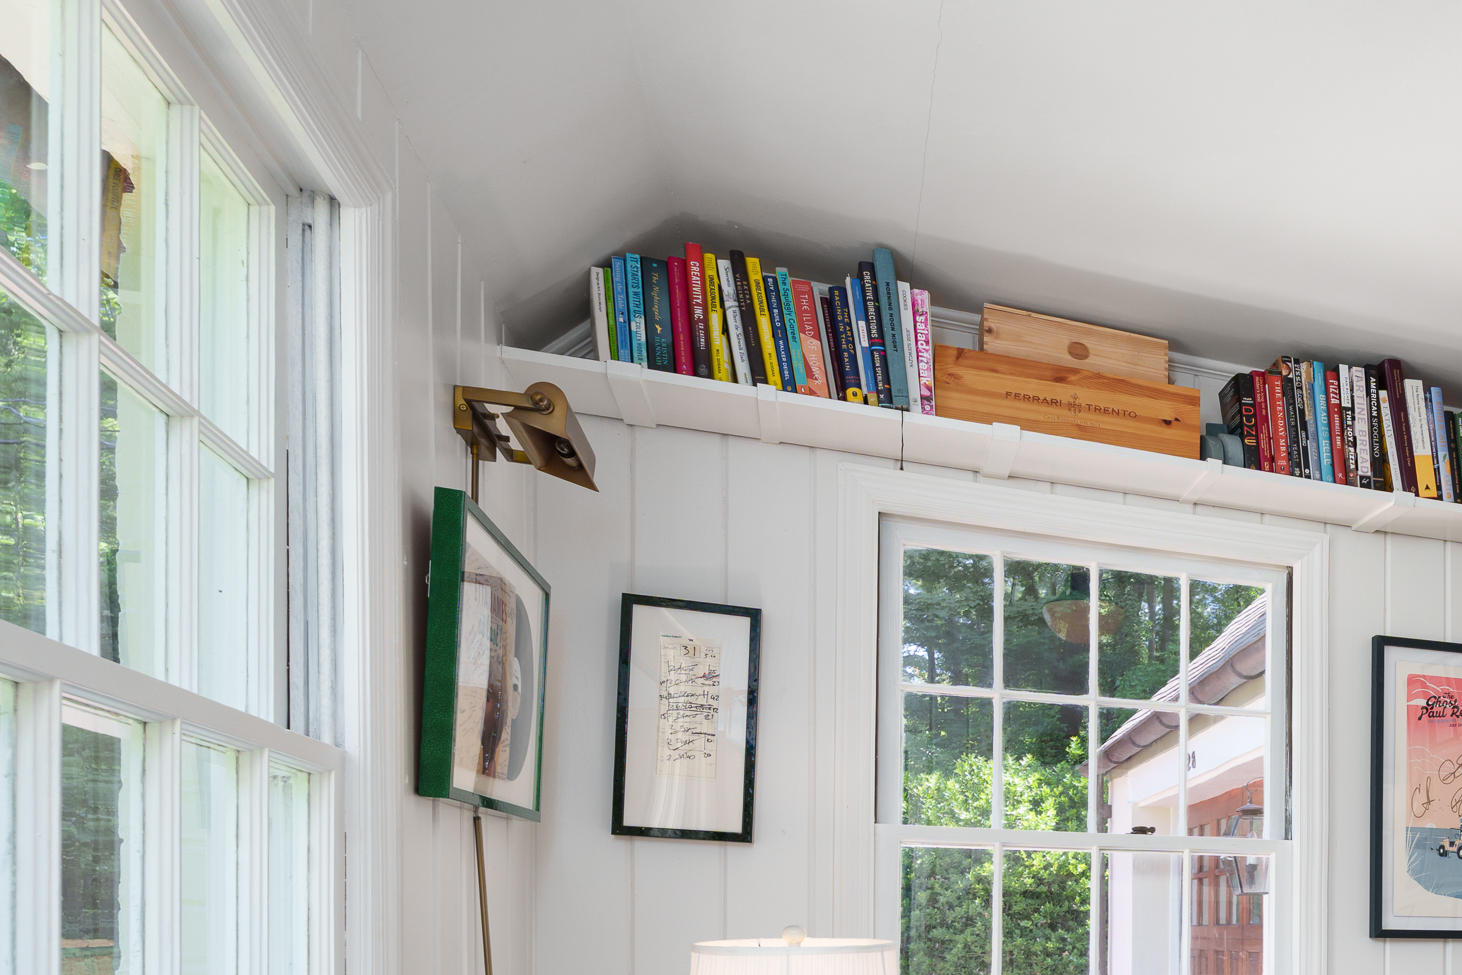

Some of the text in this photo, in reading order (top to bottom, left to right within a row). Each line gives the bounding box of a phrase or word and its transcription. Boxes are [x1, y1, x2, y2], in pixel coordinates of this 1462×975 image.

[630, 265, 640, 288] STARTS
[690, 261, 703, 321] CREATIVITY, INC.
[708, 275, 717, 312] UNREASONABLE
[632, 291, 641, 308] WITH
[651, 285, 661, 321] Nightingale
[753, 279, 771, 348] UNREASONABLE HOSPITALITY
[767, 278, 781, 327] BUY THEN BUILD
[780, 273, 798, 343] The Squiggly Career
[833, 290, 842, 321] RACING
[838, 323, 844, 331] IN
[863, 271, 878, 338] CREATIVE DIRECTIONS
[885, 281, 893, 311] MORNING
[633, 309, 642, 320] US
[711, 314, 720, 345] HOSPITALITY
[654, 336, 662, 365] HANNAH
[660, 338, 668, 365] KRISTIN
[799, 294, 823, 385] THE ILIAD OF HOMER
[848, 344, 854, 355] OF
[916, 316, 931, 385] salad freak
[778, 339, 790, 381] WALKER DEIBEL
[873, 351, 881, 366] JASON
[1005, 391, 1138, 419] FERRARI TRENTO
[1329, 380, 1340, 404] PIZZA
[1276, 401, 1285, 437] TEN-DAY
[1354, 368, 1369, 474] TARTINE BREAD
[1369, 376, 1380, 457] AMERICAN SFOGLINO
[1435, 401, 1446, 448] BITTER HONEY
[682, 646, 696, 657] 31
[1417, 705, 1447, 721] Paul
[1426, 695, 1459, 710] Ghost
